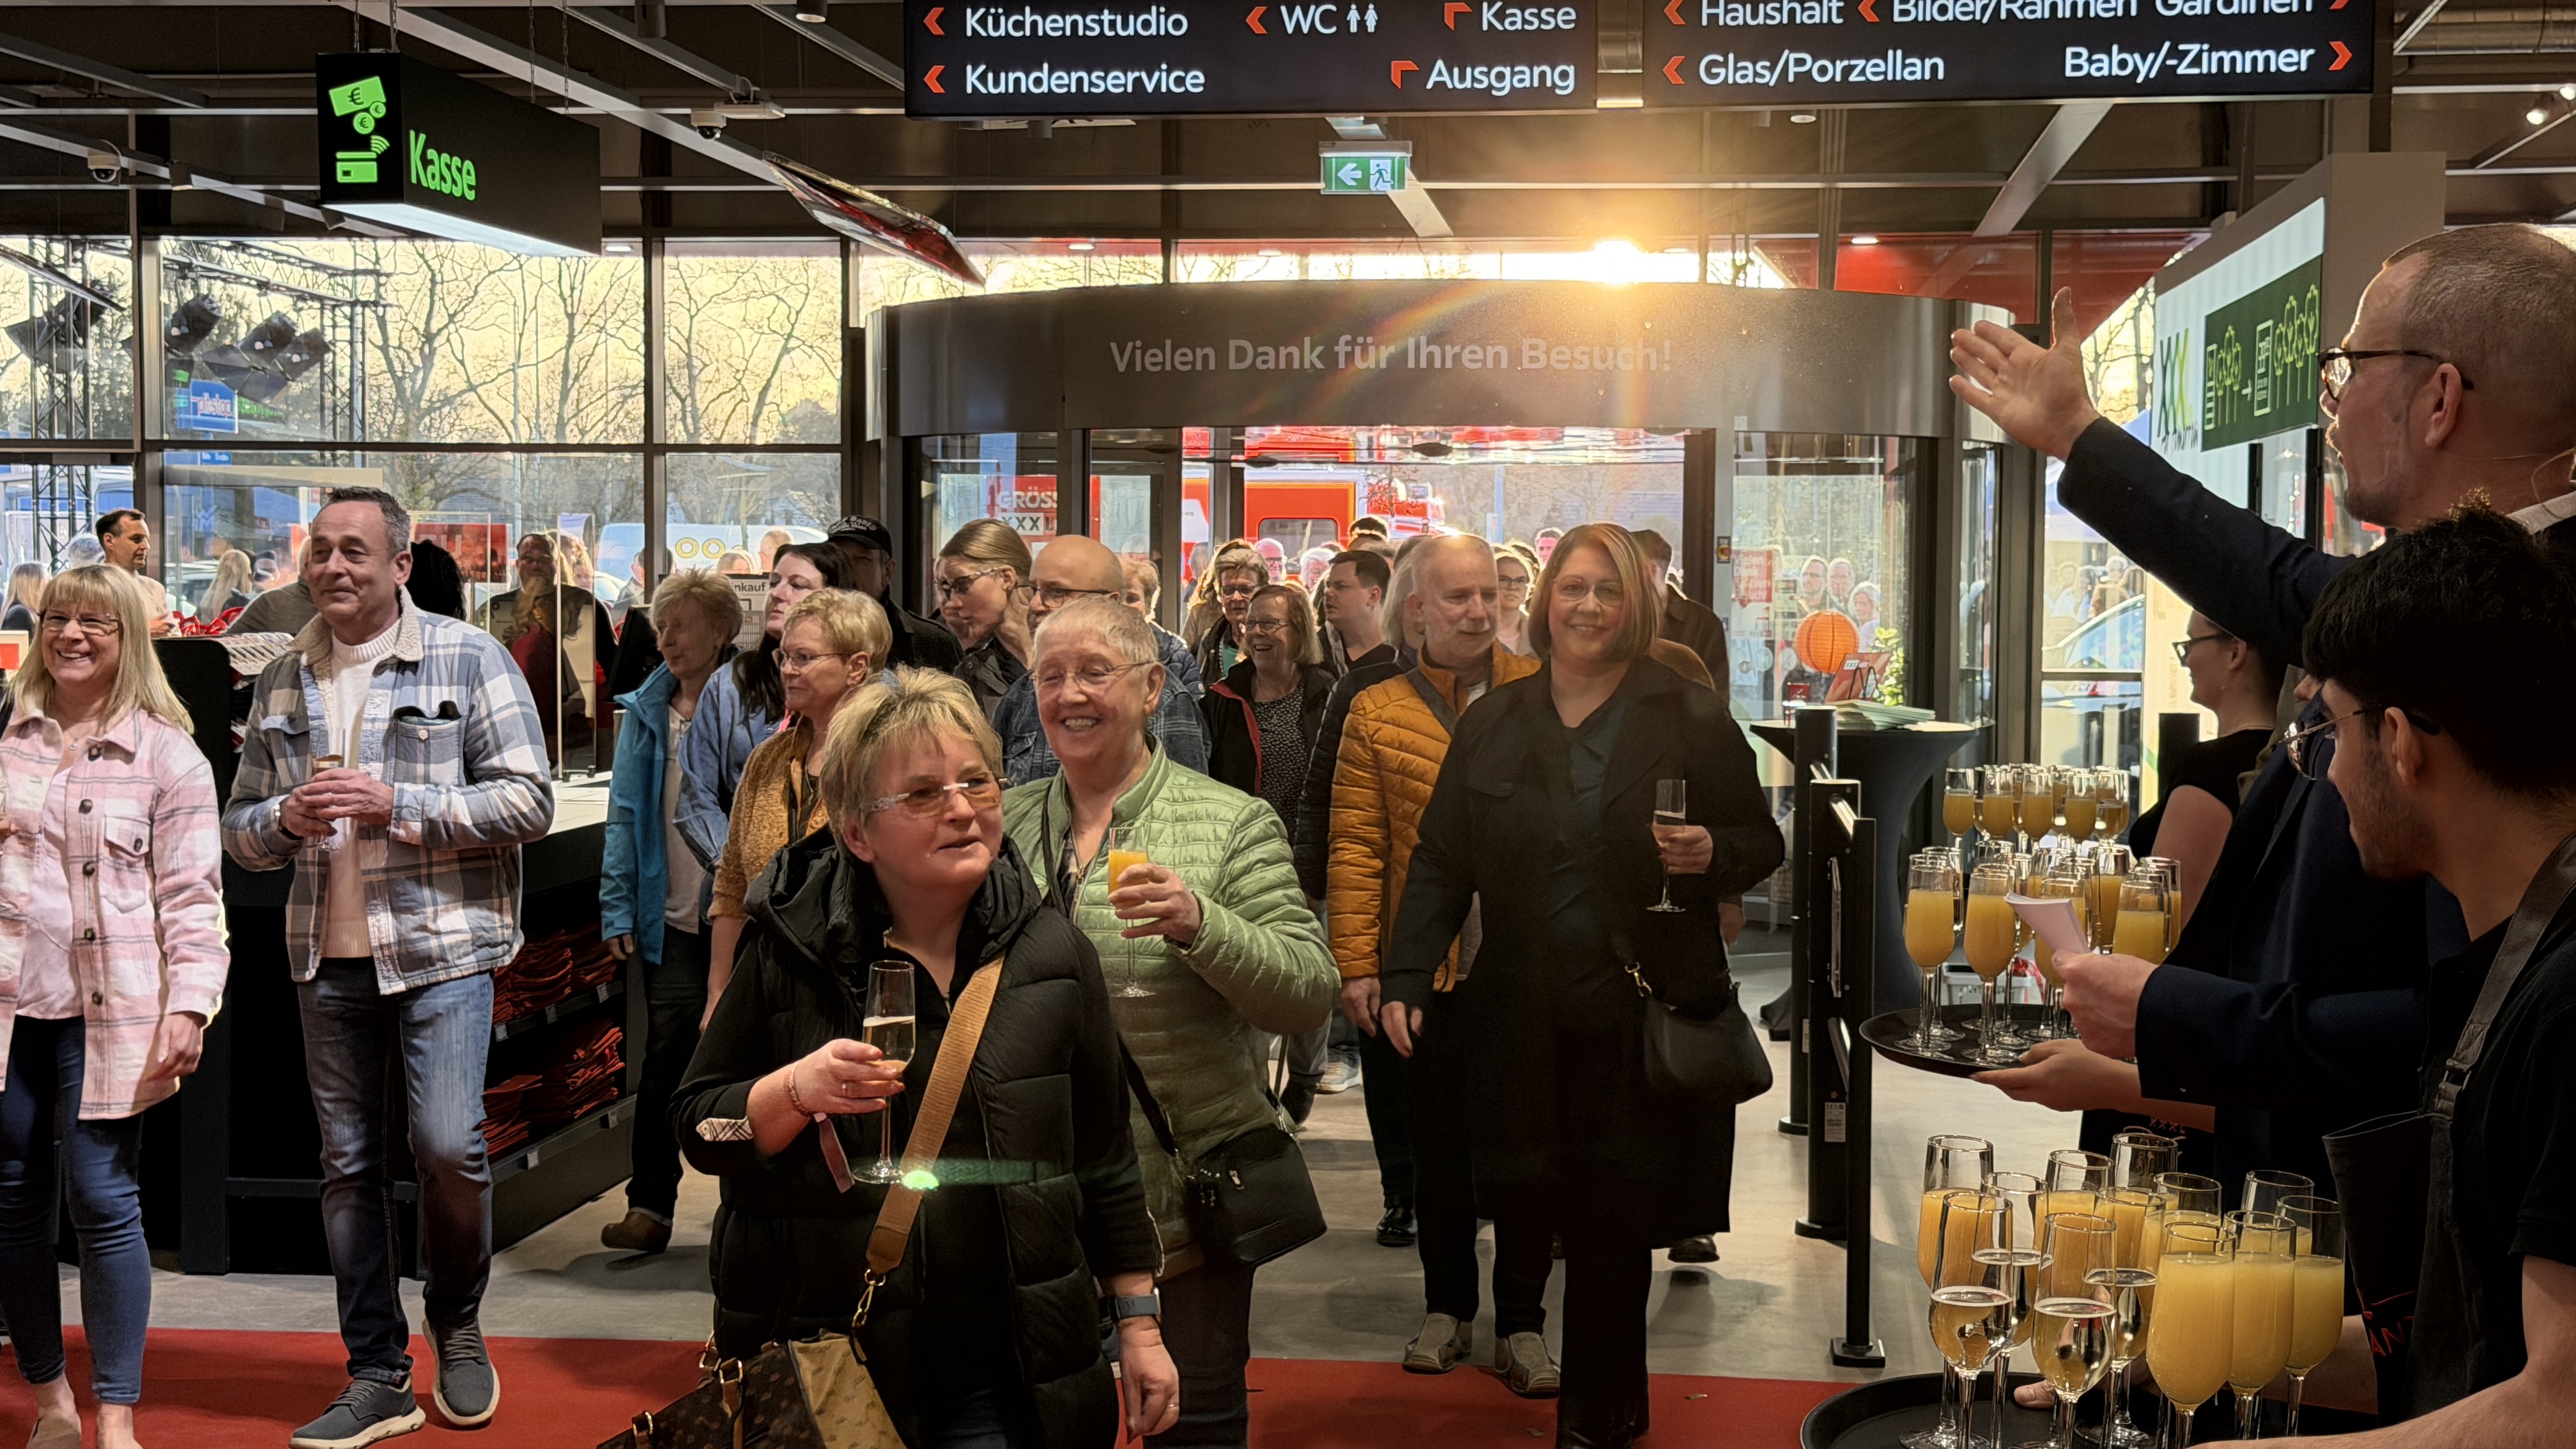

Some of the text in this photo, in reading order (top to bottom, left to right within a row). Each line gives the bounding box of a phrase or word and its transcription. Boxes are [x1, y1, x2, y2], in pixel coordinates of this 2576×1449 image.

[965, 5, 1188, 37] Küchenstudio
[1280, 4, 1337, 34] WC
[1481, 1, 1577, 31] Kasse
[1701, 0, 1844, 26] Haushalt
[965, 62, 1205, 94] Kundenservice
[1425, 58, 1575, 96] Ausgang
[1699, 49, 1945, 87] Glas/Porzellan
[2064, 41, 2315, 84] Baby/-Zimmer
[410, 129, 477, 201] Kasse
[1109, 334, 1671, 372] Vielen Dank für Ihren Besuch!
[732, 581, 767, 592] nkauf
